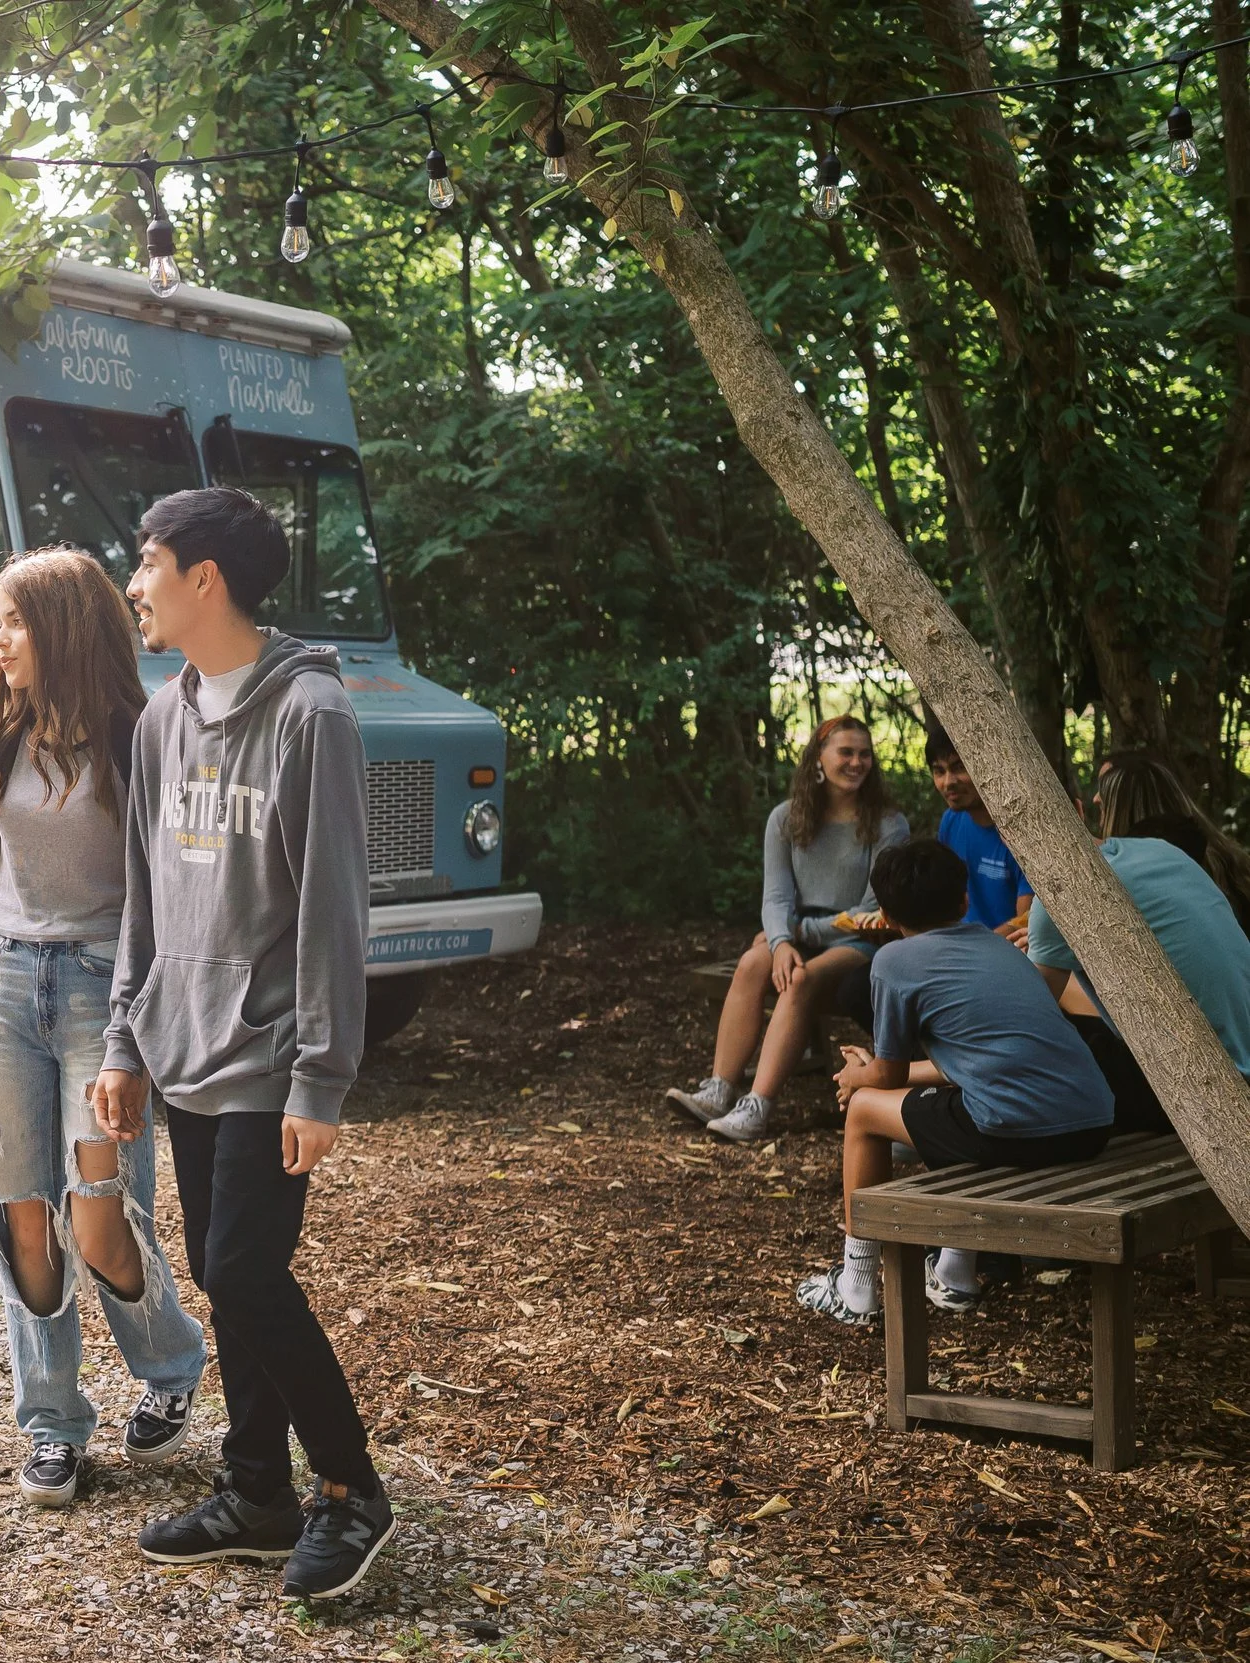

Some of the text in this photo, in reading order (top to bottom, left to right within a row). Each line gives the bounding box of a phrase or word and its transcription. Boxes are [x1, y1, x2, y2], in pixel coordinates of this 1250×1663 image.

[218, 344, 311, 388] PLANTED IN
[197, 765, 218, 779] THE
[159, 781, 265, 841] NSTITUTE
[175, 831, 197, 846] FOR
